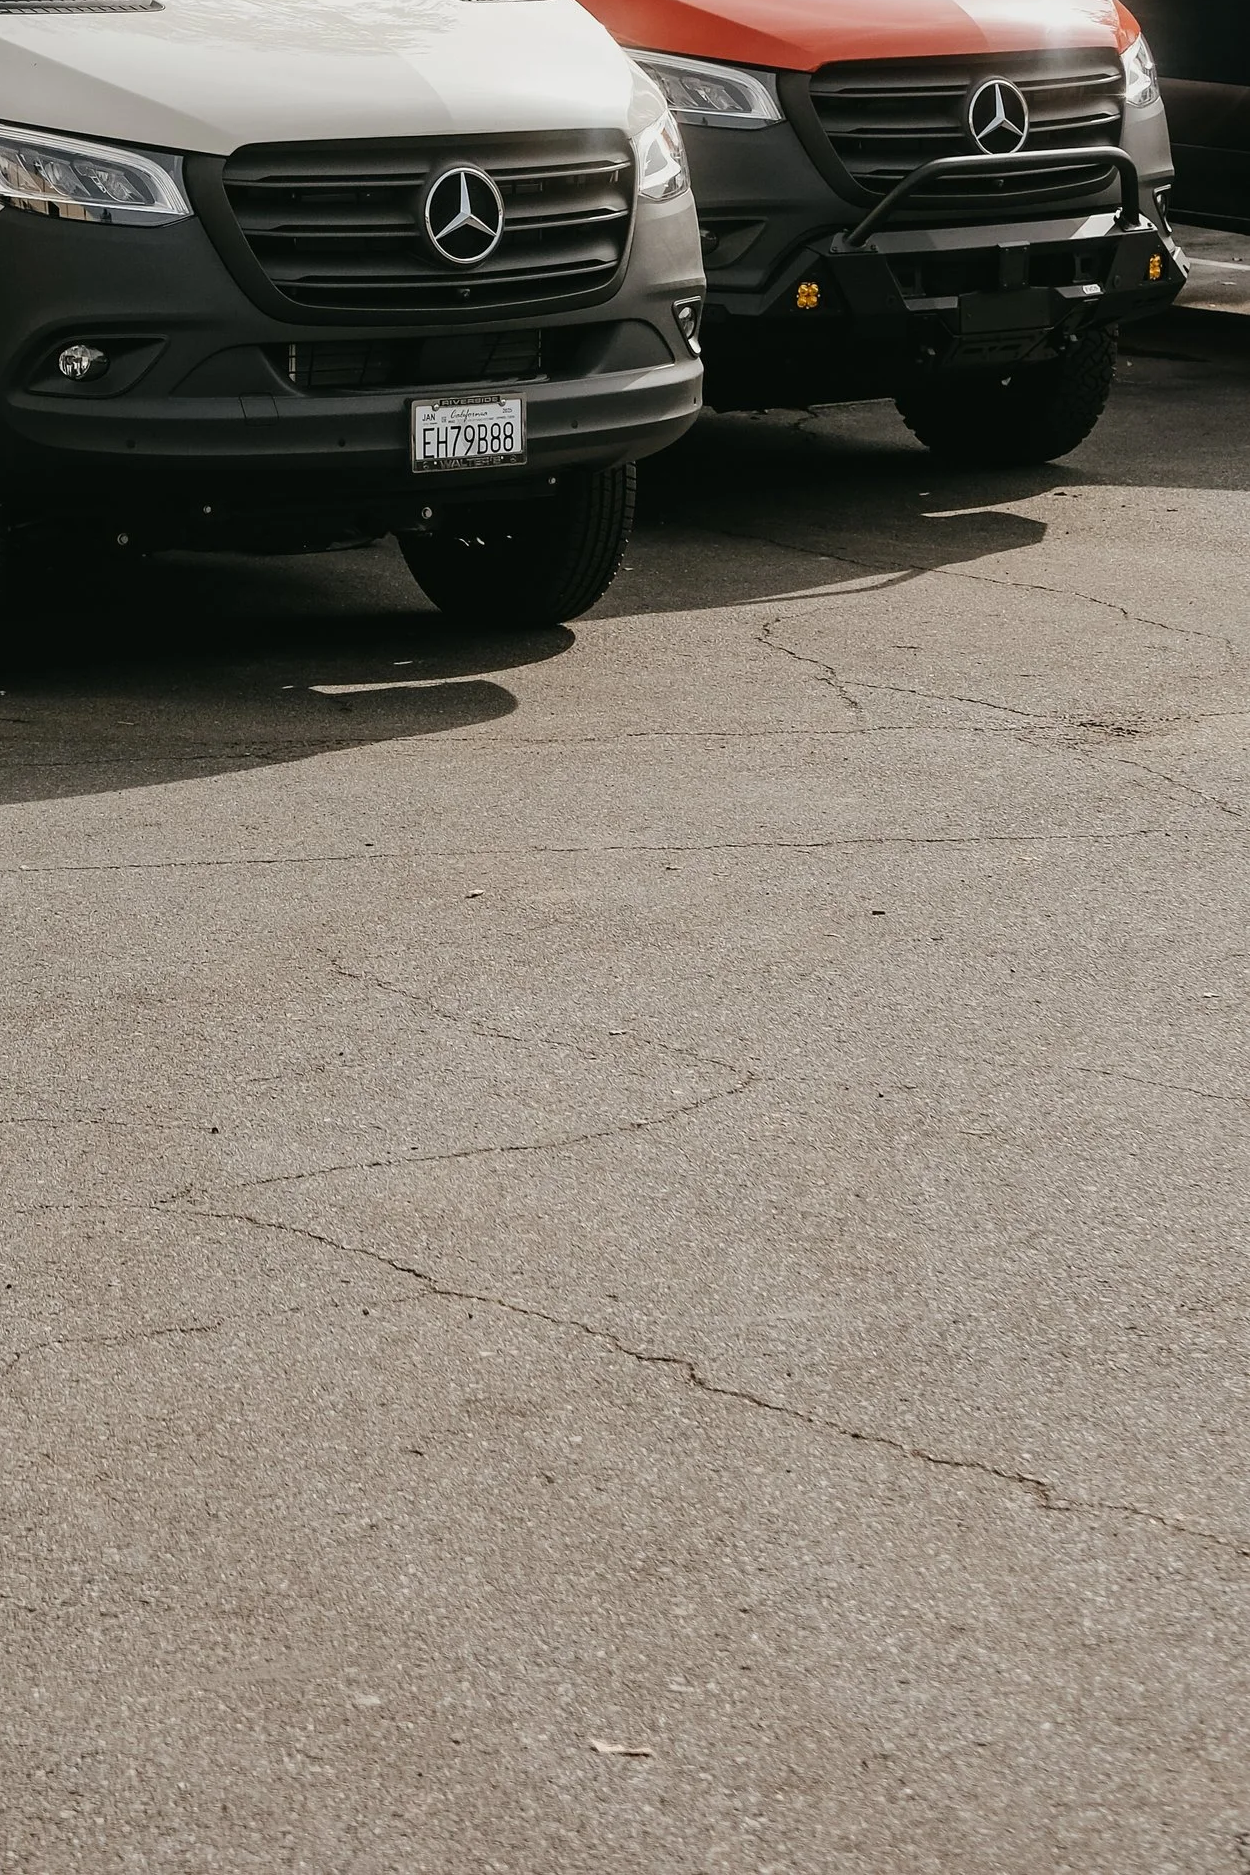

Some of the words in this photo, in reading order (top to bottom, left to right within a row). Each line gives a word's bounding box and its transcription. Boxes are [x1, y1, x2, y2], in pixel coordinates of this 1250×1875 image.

[441, 397, 499, 405] RIVERSIDE
[422, 413, 436, 422] JAN
[450, 408, 488, 423] California
[423, 422, 514, 458] EH79B88
